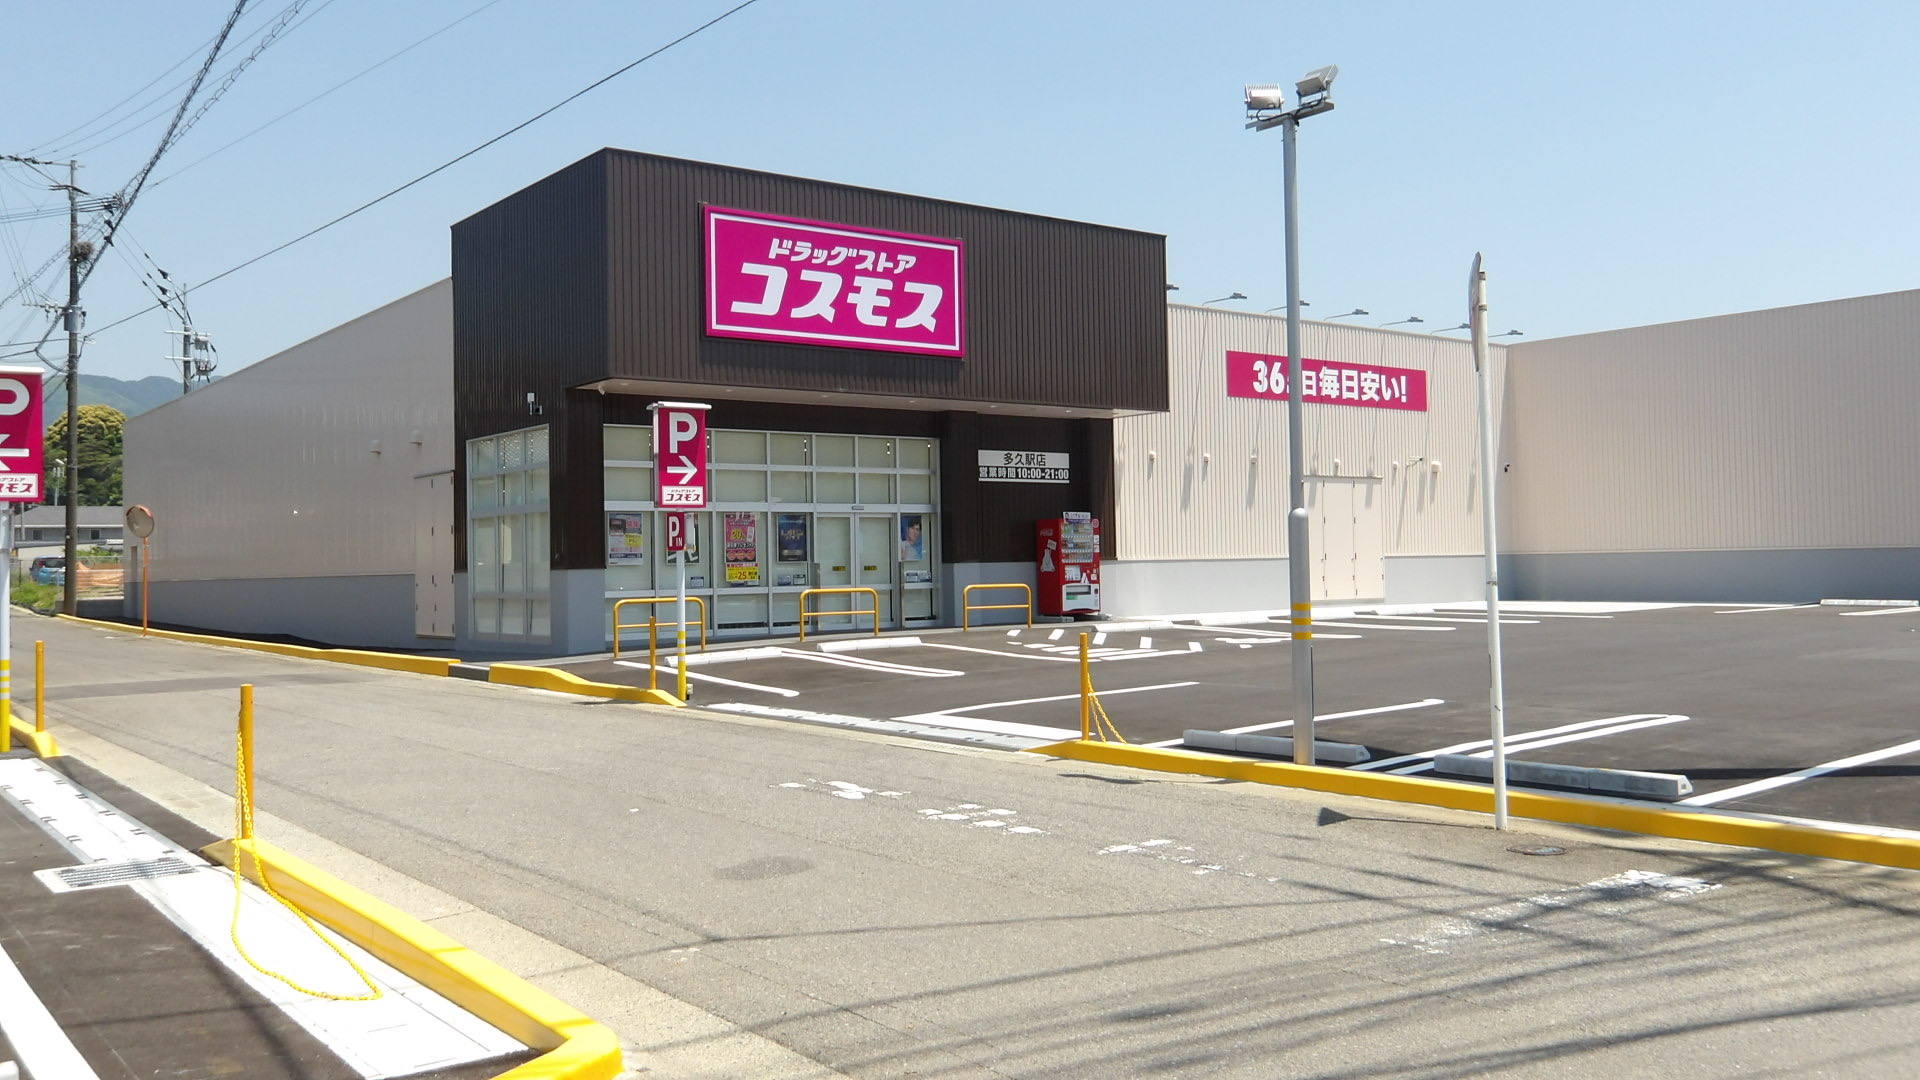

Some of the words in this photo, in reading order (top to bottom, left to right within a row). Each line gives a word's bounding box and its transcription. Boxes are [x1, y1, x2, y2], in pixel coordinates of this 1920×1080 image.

[768, 238, 917, 274] ドラッグストア
[730, 262, 943, 333] コスモス
[1252, 360, 1407, 403] 36日毎日安い!
[669, 412, 698, 453] P
[1003, 452, 1046, 466] 多久駅店
[665, 493, 701, 502] コスモス
[668, 516, 680, 547] P
[675, 537, 683, 547] IN
